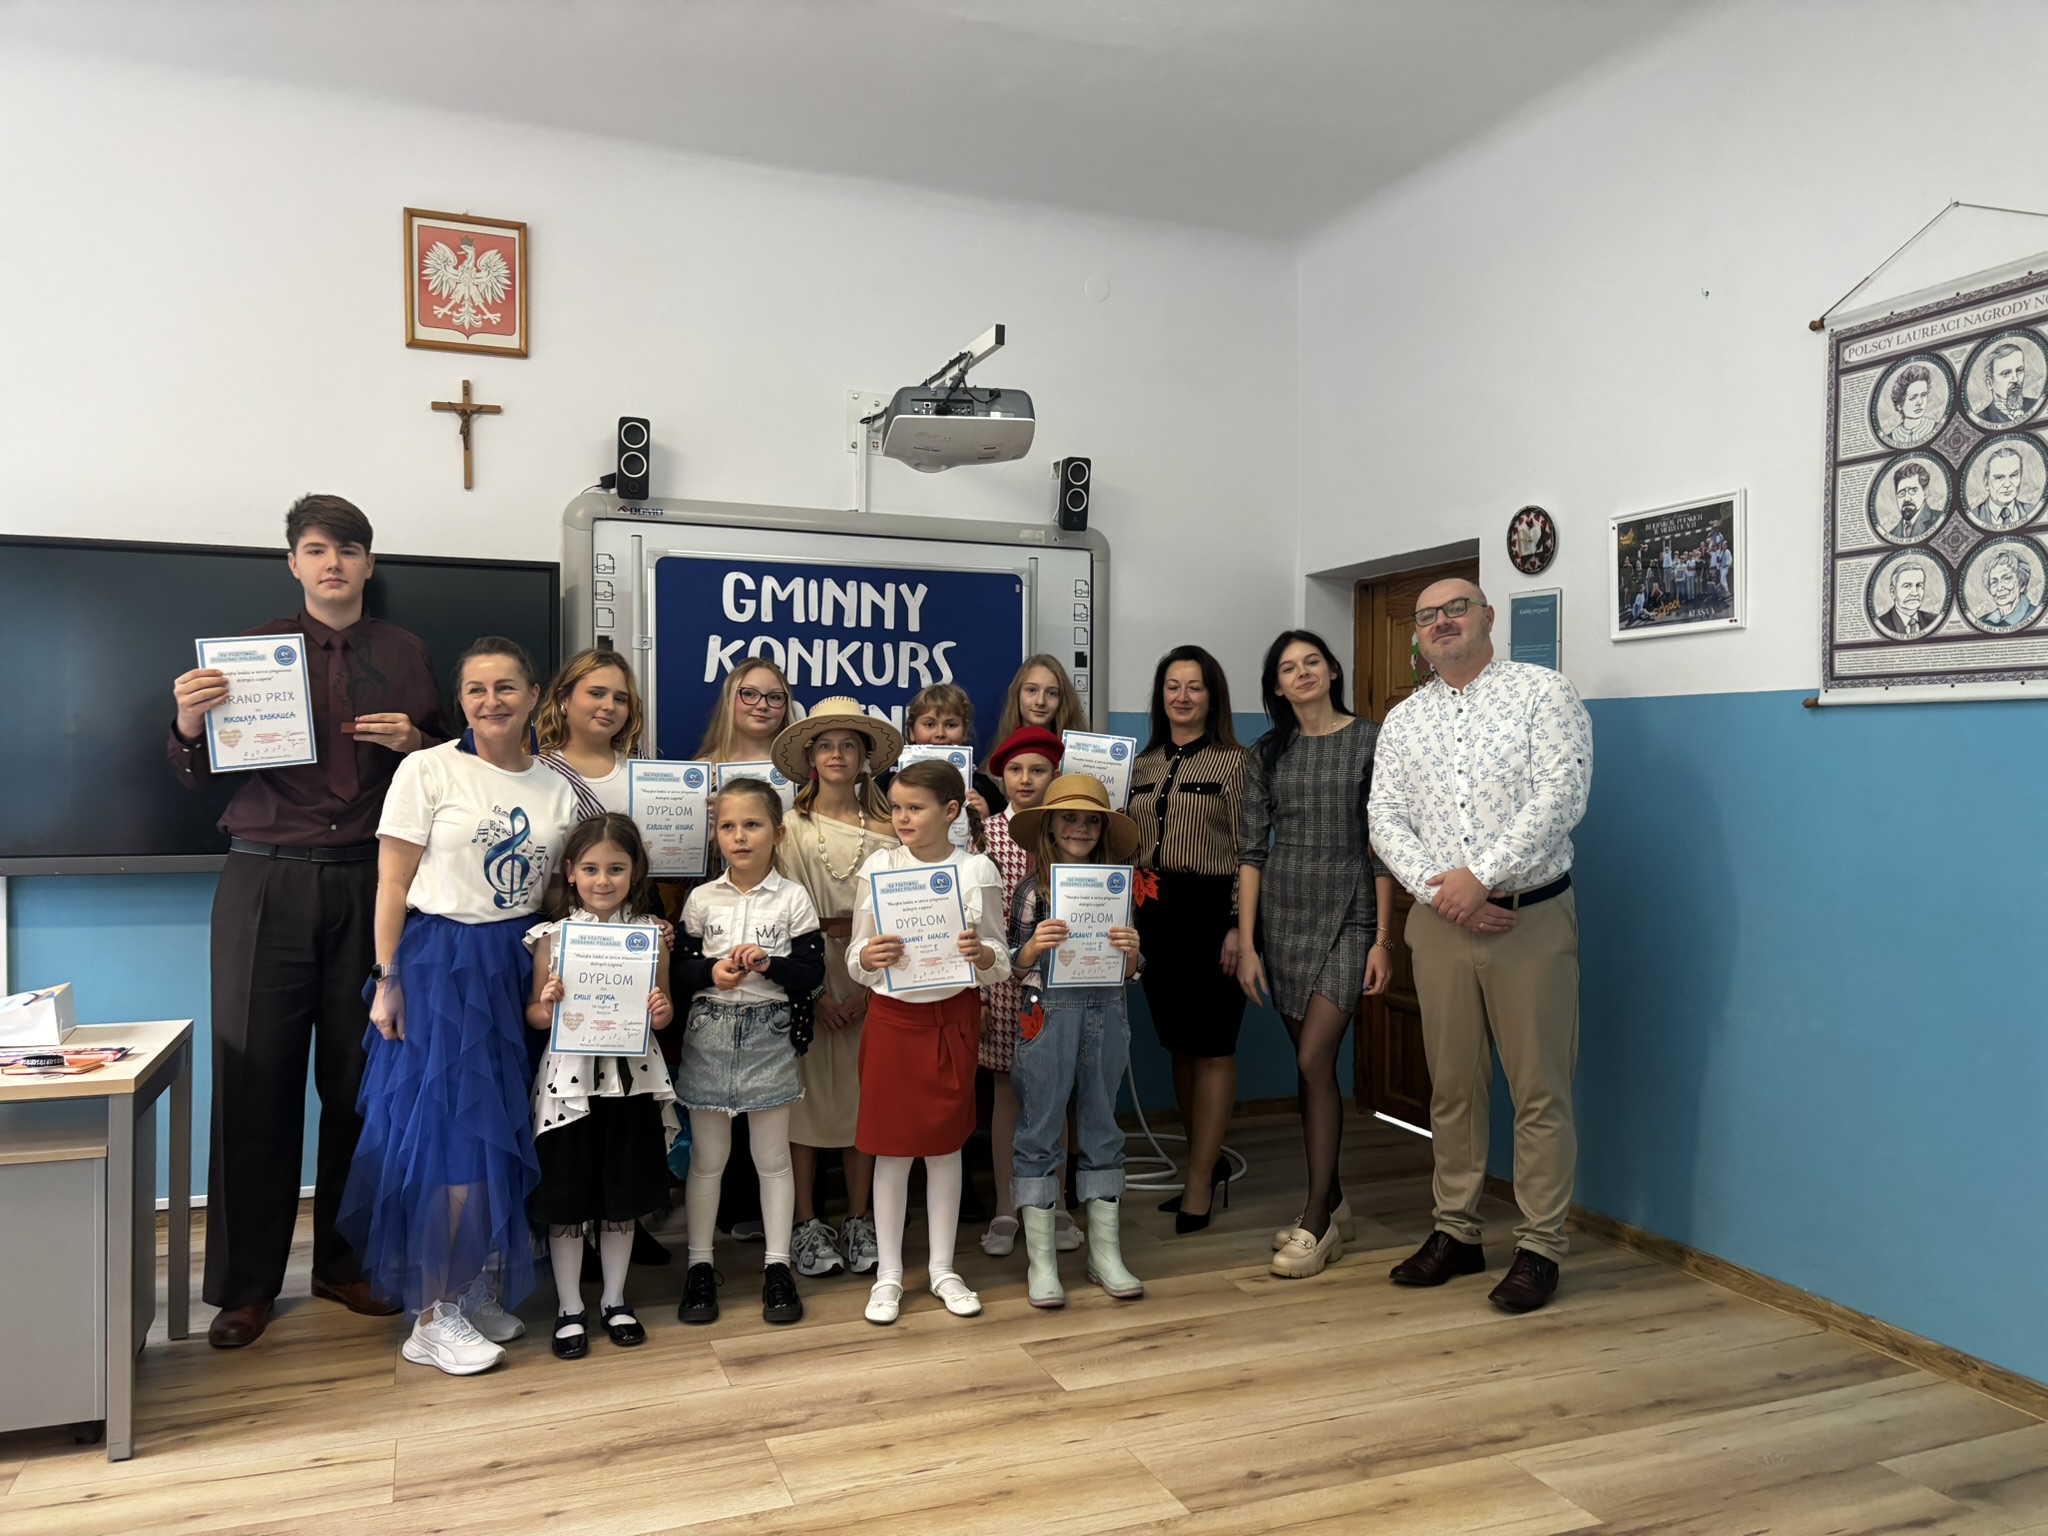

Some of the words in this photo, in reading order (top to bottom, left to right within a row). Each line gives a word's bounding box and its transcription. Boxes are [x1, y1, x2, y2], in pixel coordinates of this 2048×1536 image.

[1848, 336, 1894, 359] POLSCY
[1896, 318, 1961, 346] LAUREACI
[1963, 298, 2033, 327] NAGRODY
[722, 571, 928, 632] GMINNY
[704, 634, 957, 688] KONKURS
[266, 691, 295, 702] PRIX
[646, 805, 693, 816] DYPLOM
[895, 914, 946, 929] DYPLOM
[1070, 912, 1113, 923] DYPLOM
[579, 972, 633, 986] DYPLOM
